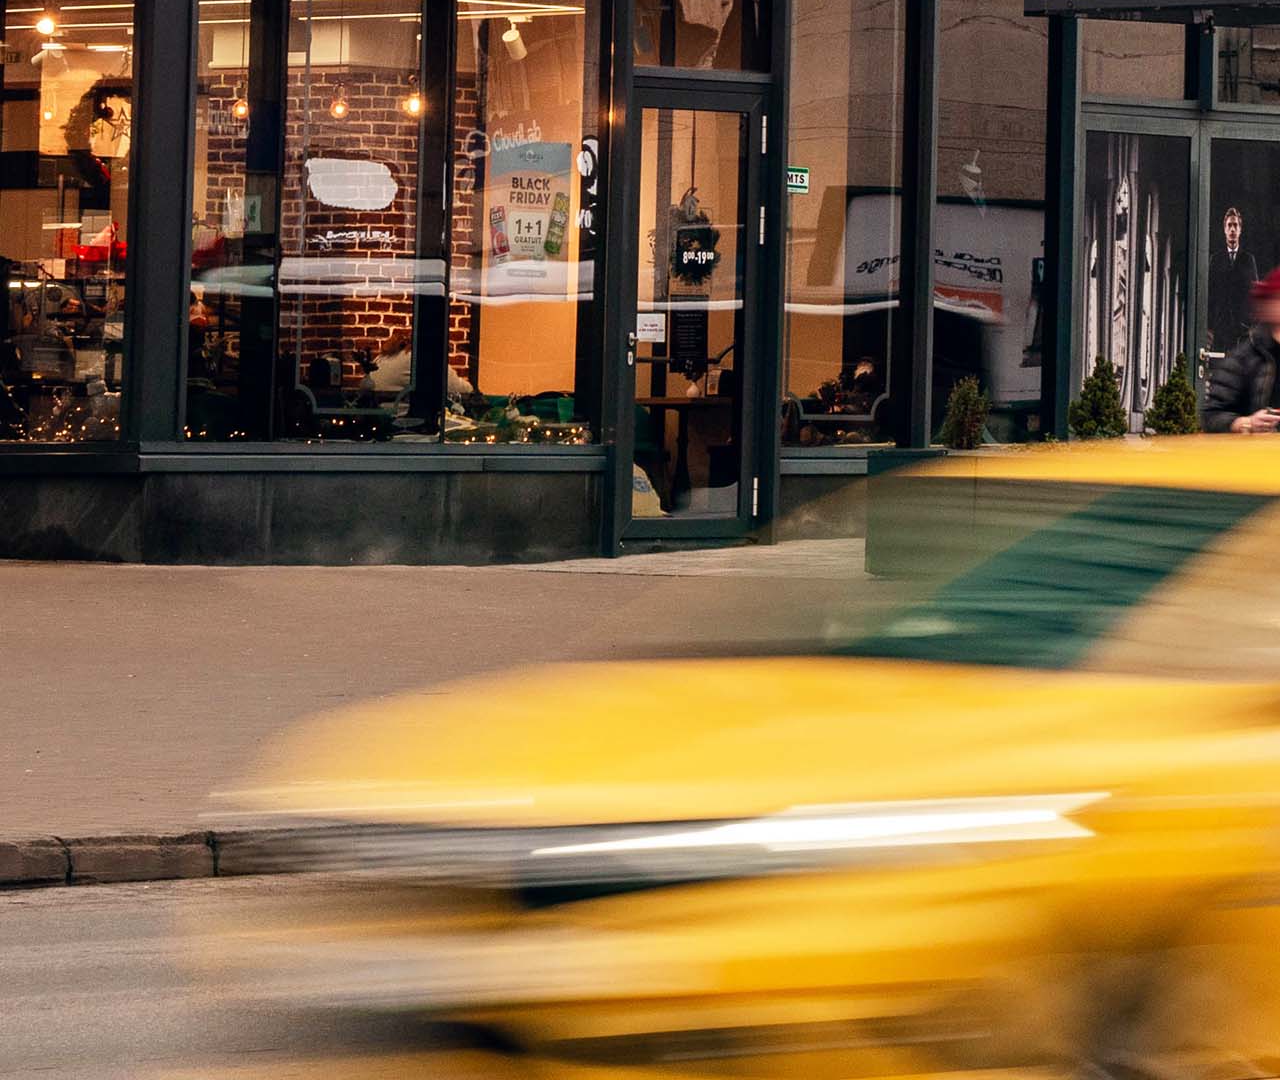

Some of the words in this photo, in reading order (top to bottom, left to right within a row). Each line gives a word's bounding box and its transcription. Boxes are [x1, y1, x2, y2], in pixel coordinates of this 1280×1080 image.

[511, 176, 550, 191] BLACK
[509, 191, 551, 205] FRIDAY
[515, 218, 542, 236] 1+1
